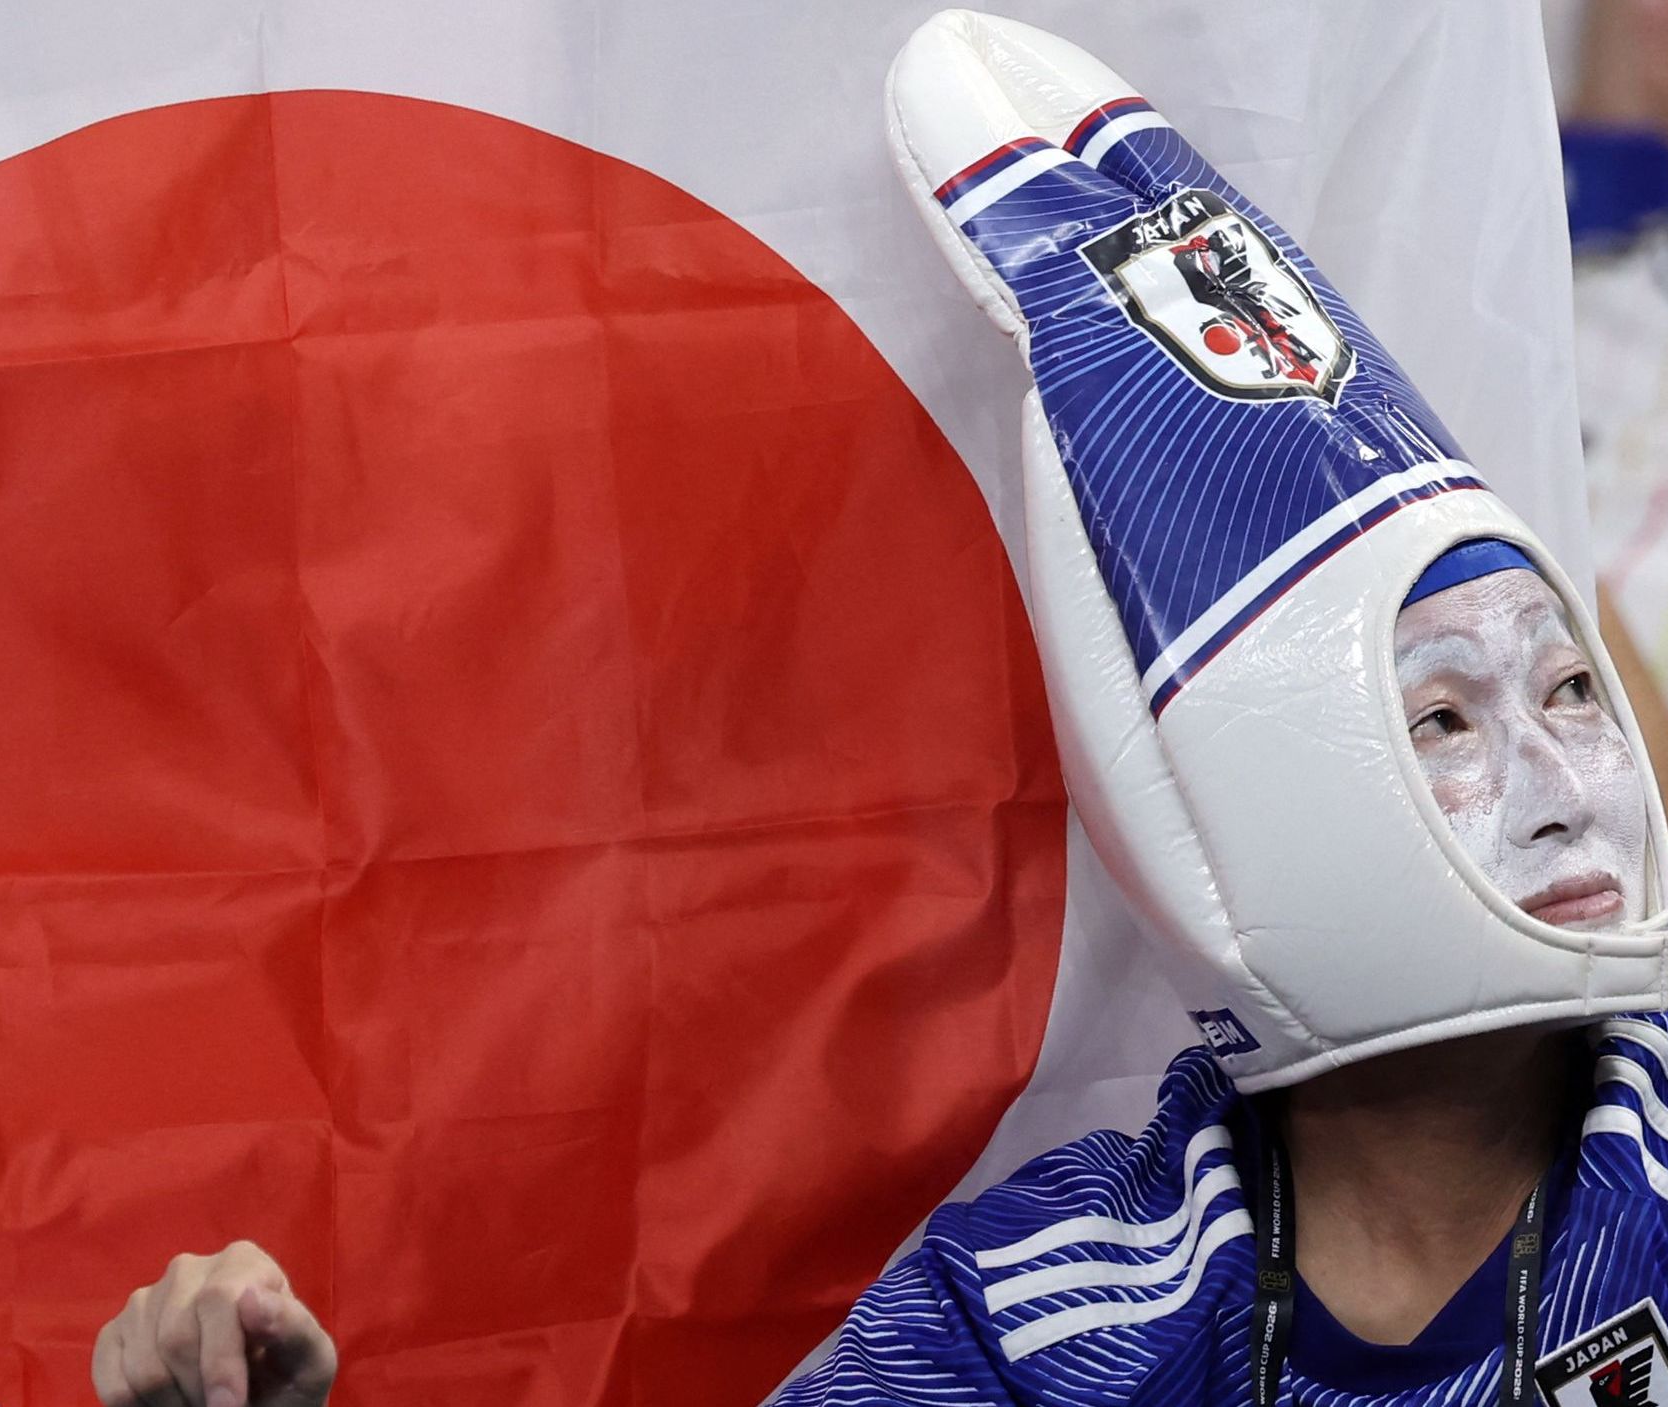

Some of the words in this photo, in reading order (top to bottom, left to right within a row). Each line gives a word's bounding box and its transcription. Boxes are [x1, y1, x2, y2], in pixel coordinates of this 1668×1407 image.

[1273, 1179, 1281, 1199] CUP
[1272, 1200, 1282, 1235] WORLD
[1271, 1237, 1281, 1259] FIFA
[1519, 1269, 1528, 1293] FIFA
[1517, 1295, 1526, 1335] WORLD
[1260, 1343, 1271, 1365] CUP
[1516, 1336, 1525, 1358] CUP
[1565, 1326, 1628, 1373] JAPAN
